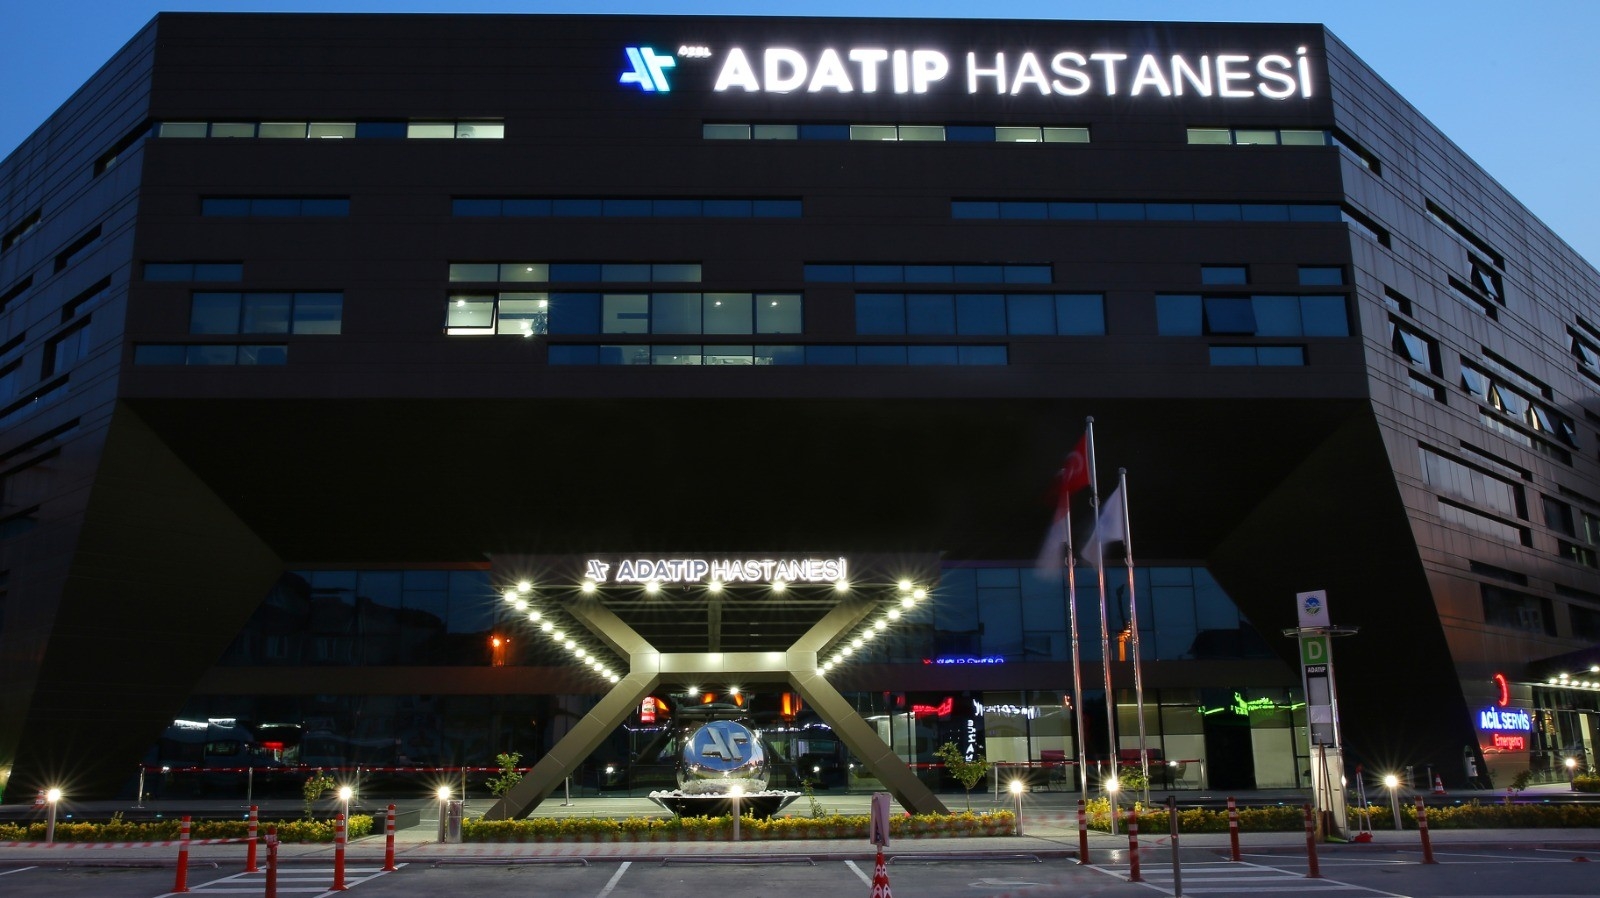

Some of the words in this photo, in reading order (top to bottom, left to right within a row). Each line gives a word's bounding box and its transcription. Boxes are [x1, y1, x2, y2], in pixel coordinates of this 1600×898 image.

[713, 47, 949, 94] ADATIP
[966, 47, 1312, 100] HASTANESİ
[615, 559, 709, 582] ADATIP
[711, 556, 846, 582] HASTANESİ
[1307, 641, 1322, 659] D
[1481, 706, 1502, 729] ACİL
[1502, 709, 1530, 731] SERVİS
[1494, 733, 1524, 750] Emergency
